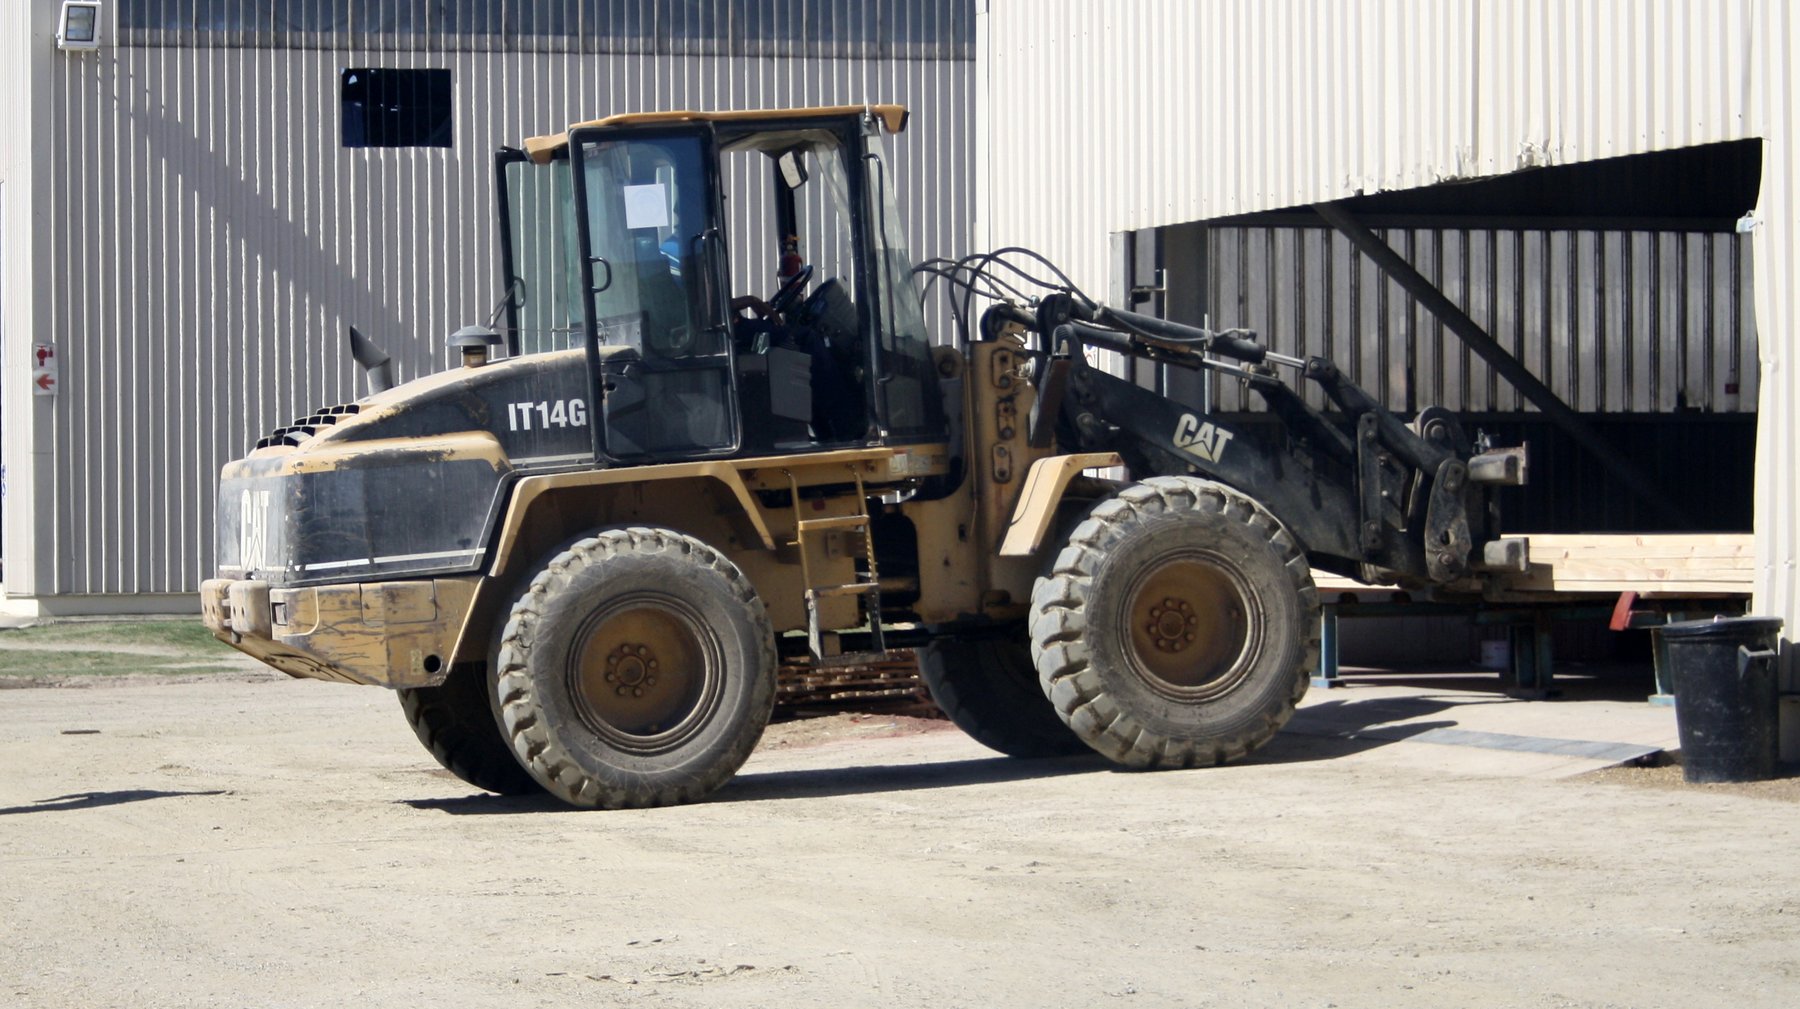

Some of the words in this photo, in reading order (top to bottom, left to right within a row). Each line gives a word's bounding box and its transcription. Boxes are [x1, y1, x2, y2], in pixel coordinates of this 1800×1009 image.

[508, 398, 587, 431] IT14G
[1173, 413, 1234, 464] CAT
[240, 489, 269, 570] CAT
